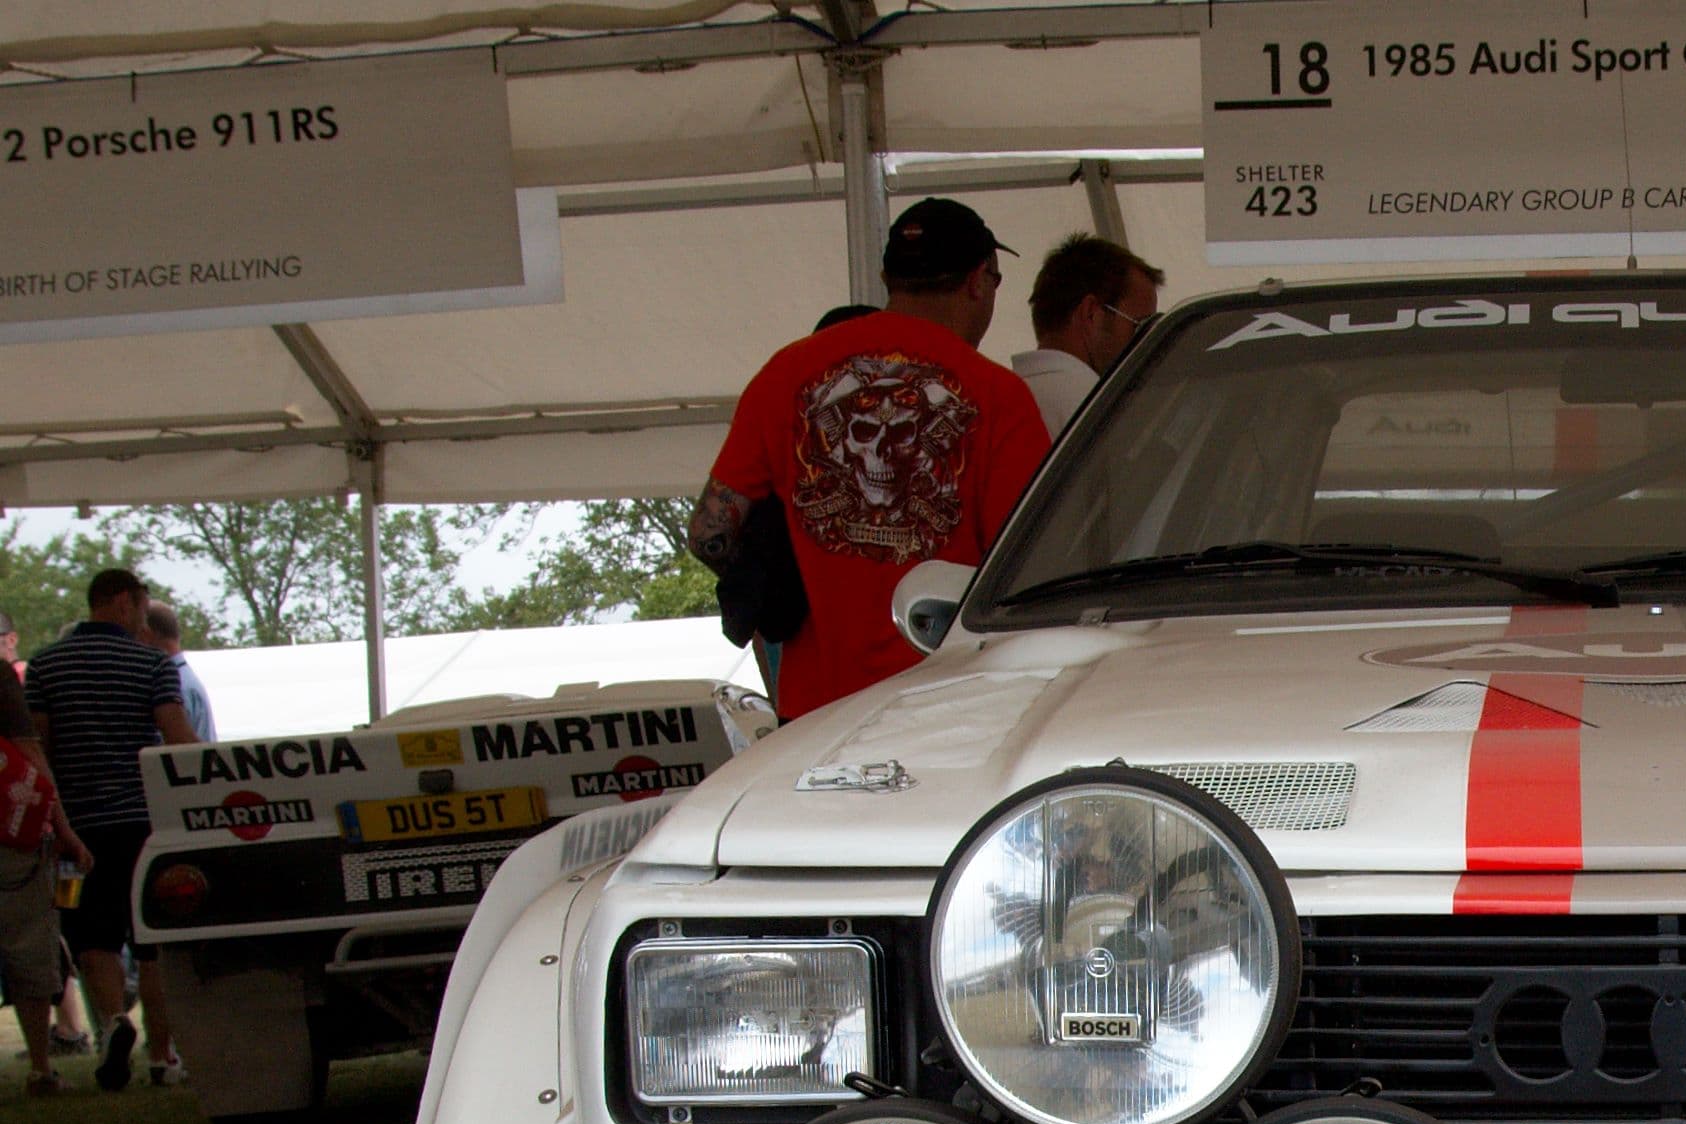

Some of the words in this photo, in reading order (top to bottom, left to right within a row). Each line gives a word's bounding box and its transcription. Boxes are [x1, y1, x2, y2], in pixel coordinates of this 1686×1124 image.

[1262, 42, 1331, 96] 18
[1363, 43, 1456, 78] 1985
[1469, 39, 1557, 76] Audi
[1571, 38, 1670, 82] Sport
[4, 129, 28, 162] 2
[42, 116, 197, 161] Porsche
[213, 105, 341, 147] 911RS
[1235, 164, 1326, 184] SHELTER
[1244, 184, 1319, 219] 423
[1367, 189, 1516, 216] LEGENDARY
[1522, 187, 1615, 212] GROUP
[1621, 187, 1636, 210] B
[64, 270, 98, 293] OF
[106, 264, 182, 290] STAGE
[190, 255, 303, 283] RALLYING
[1206, 299, 1531, 352] Audi
[161, 736, 366, 788] LANCIA
[471, 706, 698, 763] MARTINI
[576, 765, 702, 796] MARTINI
[186, 801, 310, 832] MARTINI
[388, 795, 454, 836] DUS
[466, 792, 507, 825] 5T
[1069, 1021, 1130, 1037] BOSCH
